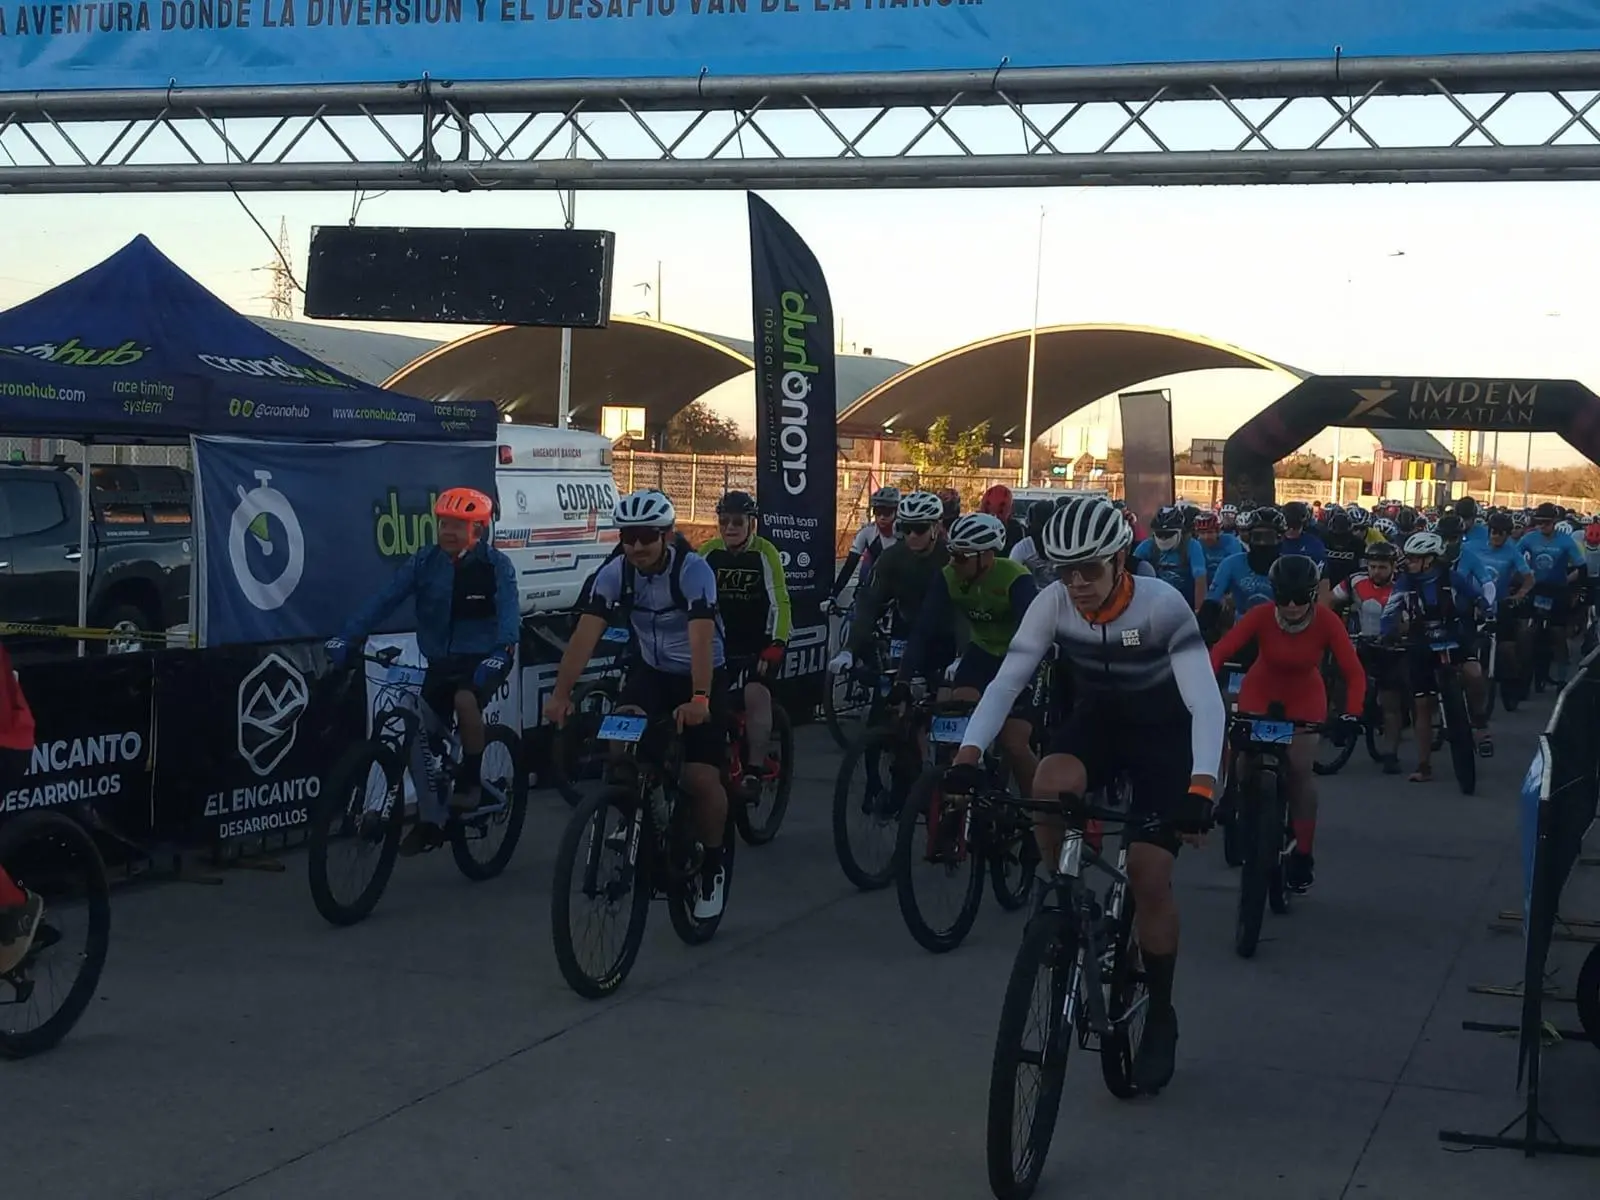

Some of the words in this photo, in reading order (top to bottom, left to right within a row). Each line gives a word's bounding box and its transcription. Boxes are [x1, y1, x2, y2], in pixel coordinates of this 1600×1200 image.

[16, 2, 150, 35] AVENTURA
[161, 0, 251, 31] DONDE
[263, 0, 295, 27] LA
[113, 380, 138, 394] race
[140, 380, 175, 401] timing
[1410, 380, 1539, 405] IMDEM
[123, 400, 162, 415] system
[254, 404, 311, 418] @cronohub
[557, 483, 614, 511] COBRAS
[616, 721, 630, 731] 42
[24, 731, 143, 777] NCANTO
[204, 792, 229, 817] EL
[232, 775, 321, 814] ENCANTO
[219, 807, 308, 840] DESARROLLOS
